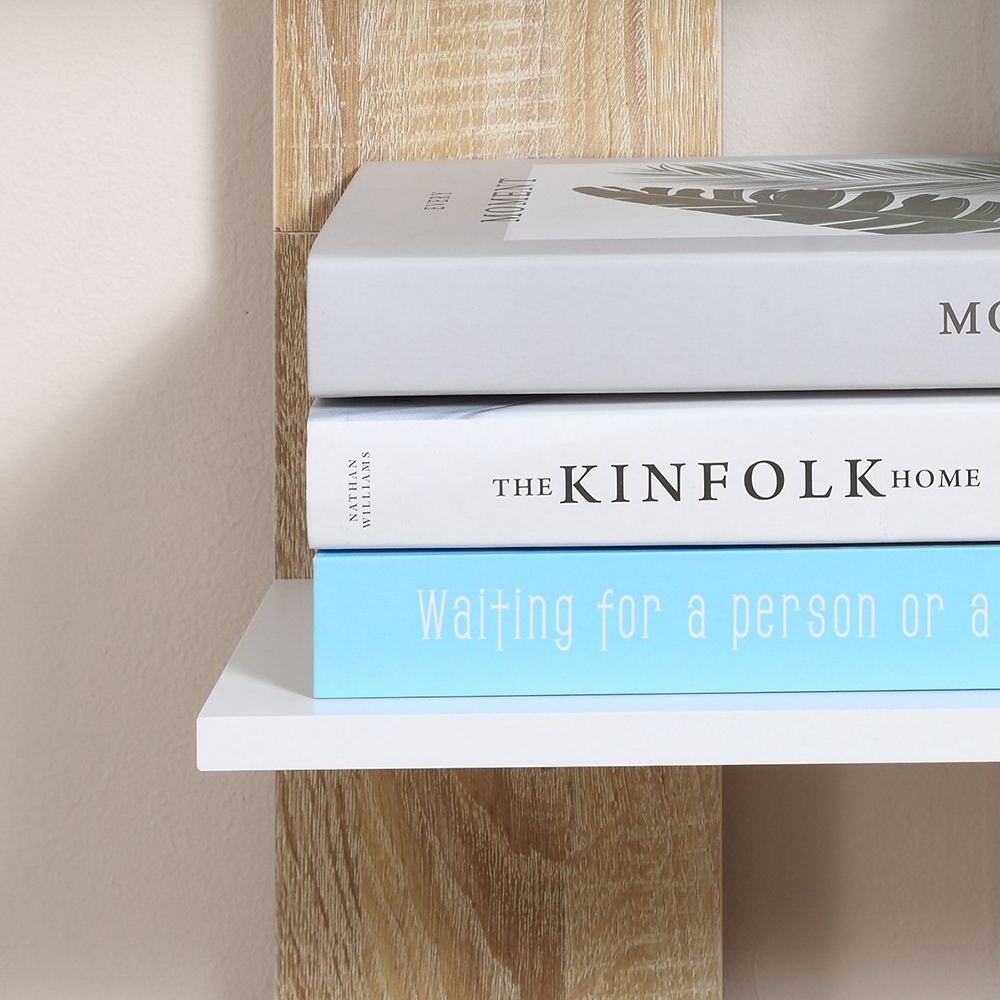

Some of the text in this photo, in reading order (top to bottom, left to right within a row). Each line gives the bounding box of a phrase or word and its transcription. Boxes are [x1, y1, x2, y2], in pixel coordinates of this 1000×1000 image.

[480, 178, 537, 223] MOMENT
[347, 458, 358, 523] NATHAN
[361, 450, 372, 529] WILLIAMS
[491, 457, 982, 505] THE KINFOLK HOME
[416, 587, 574, 652] Waiting
[596, 588, 663, 652] for
[687, 594, 707, 639] a
[731, 592, 878, 651] person
[901, 593, 945, 638] or
[970, 592, 990, 638] a
